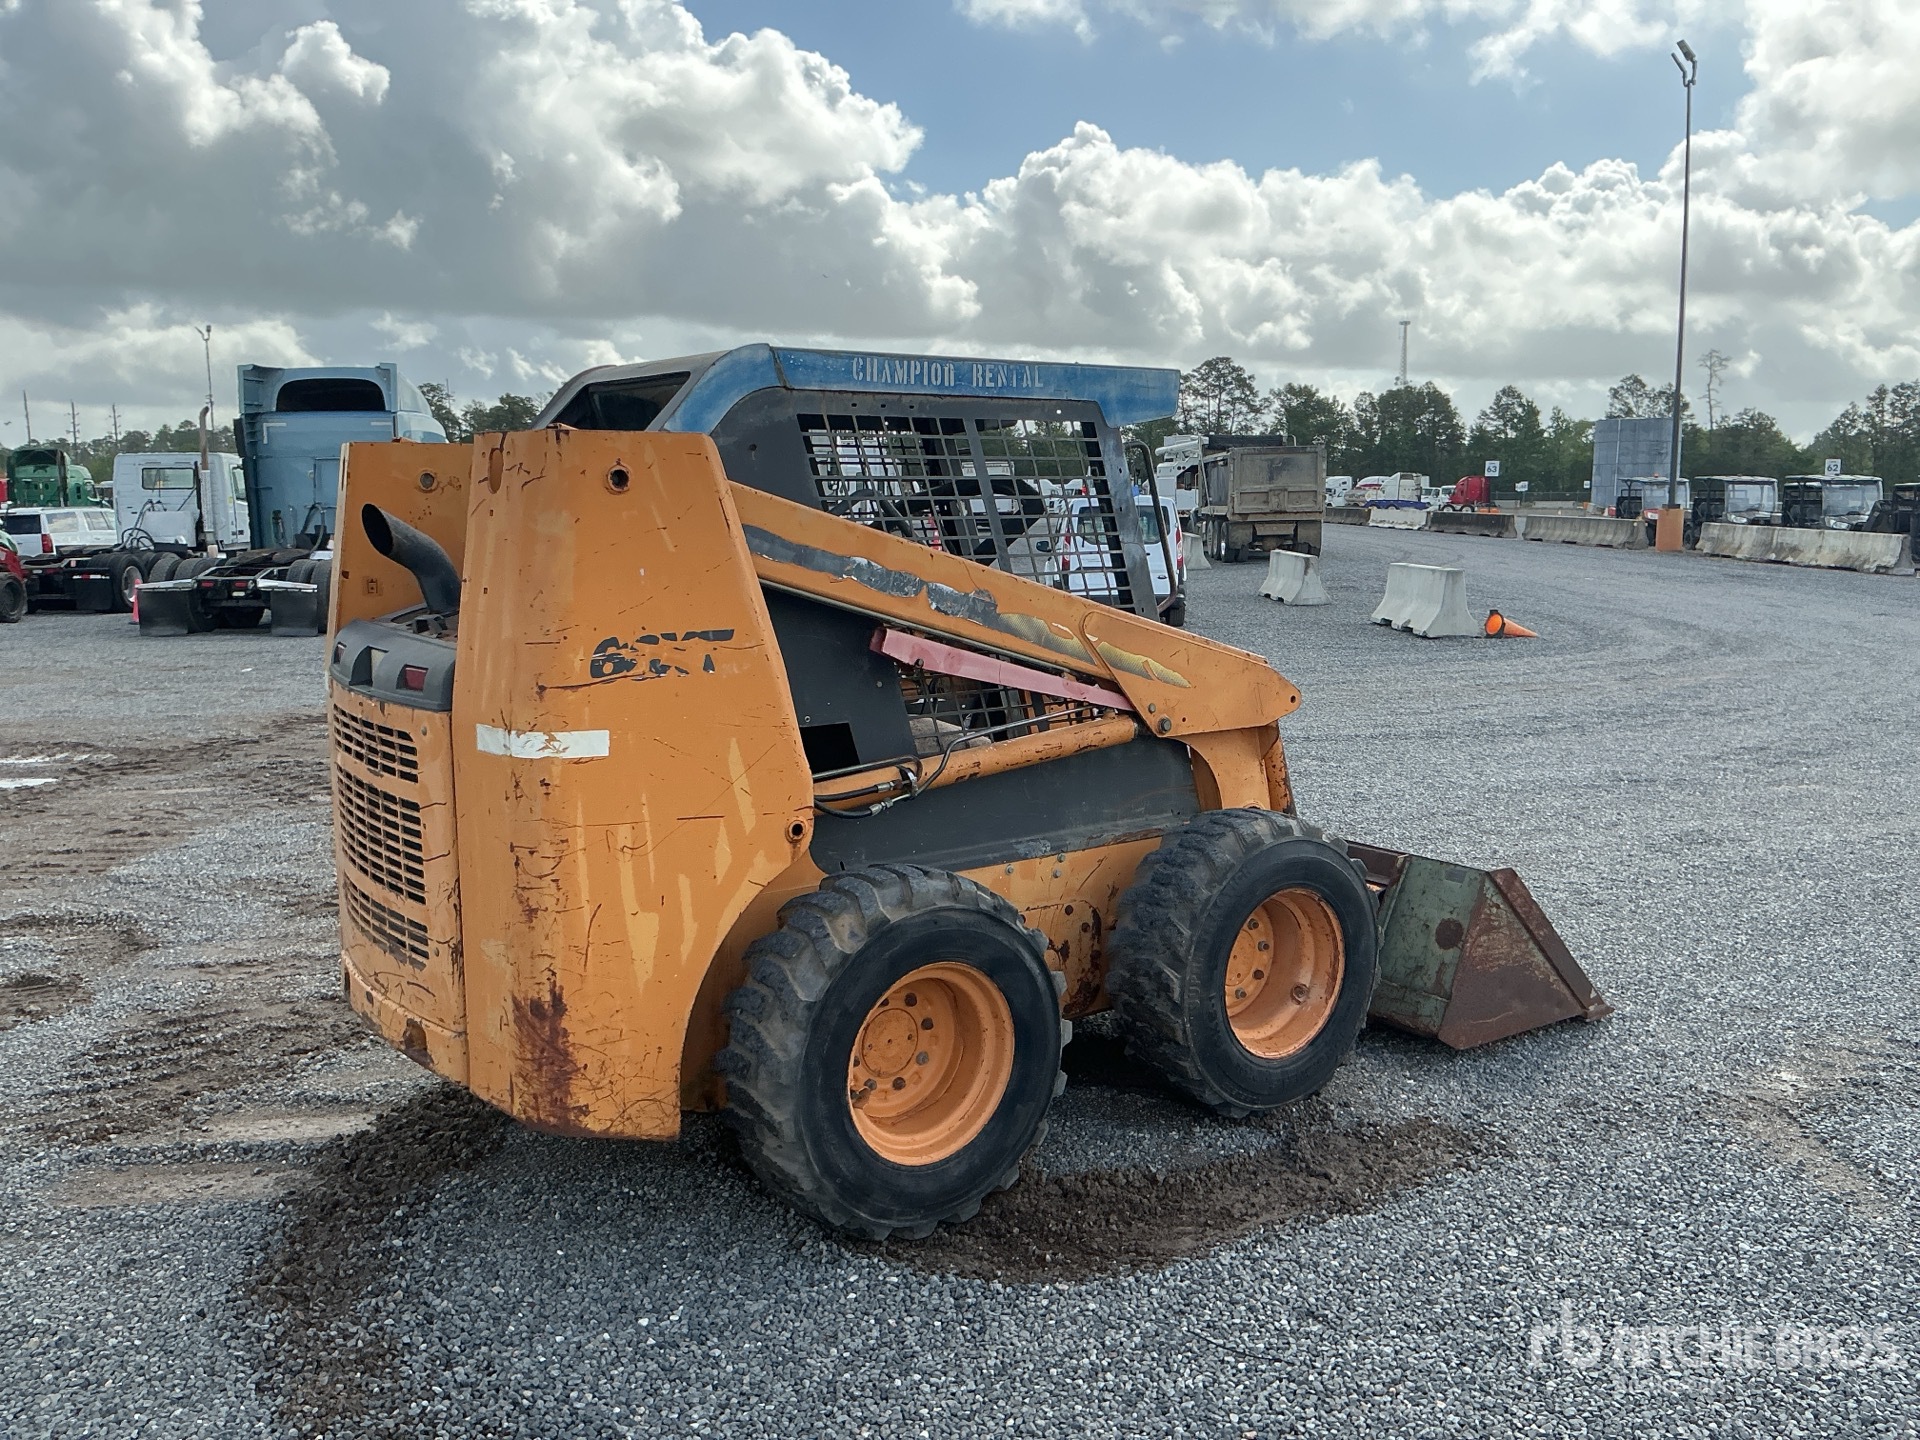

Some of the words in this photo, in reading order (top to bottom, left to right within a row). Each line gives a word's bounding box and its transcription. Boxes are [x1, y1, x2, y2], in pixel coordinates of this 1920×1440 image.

[851, 356, 955, 387] CHAMPION
[972, 363, 1044, 388] RENTAL
[1487, 465, 1498, 473] 63
[1827, 464, 1839, 472] 62
